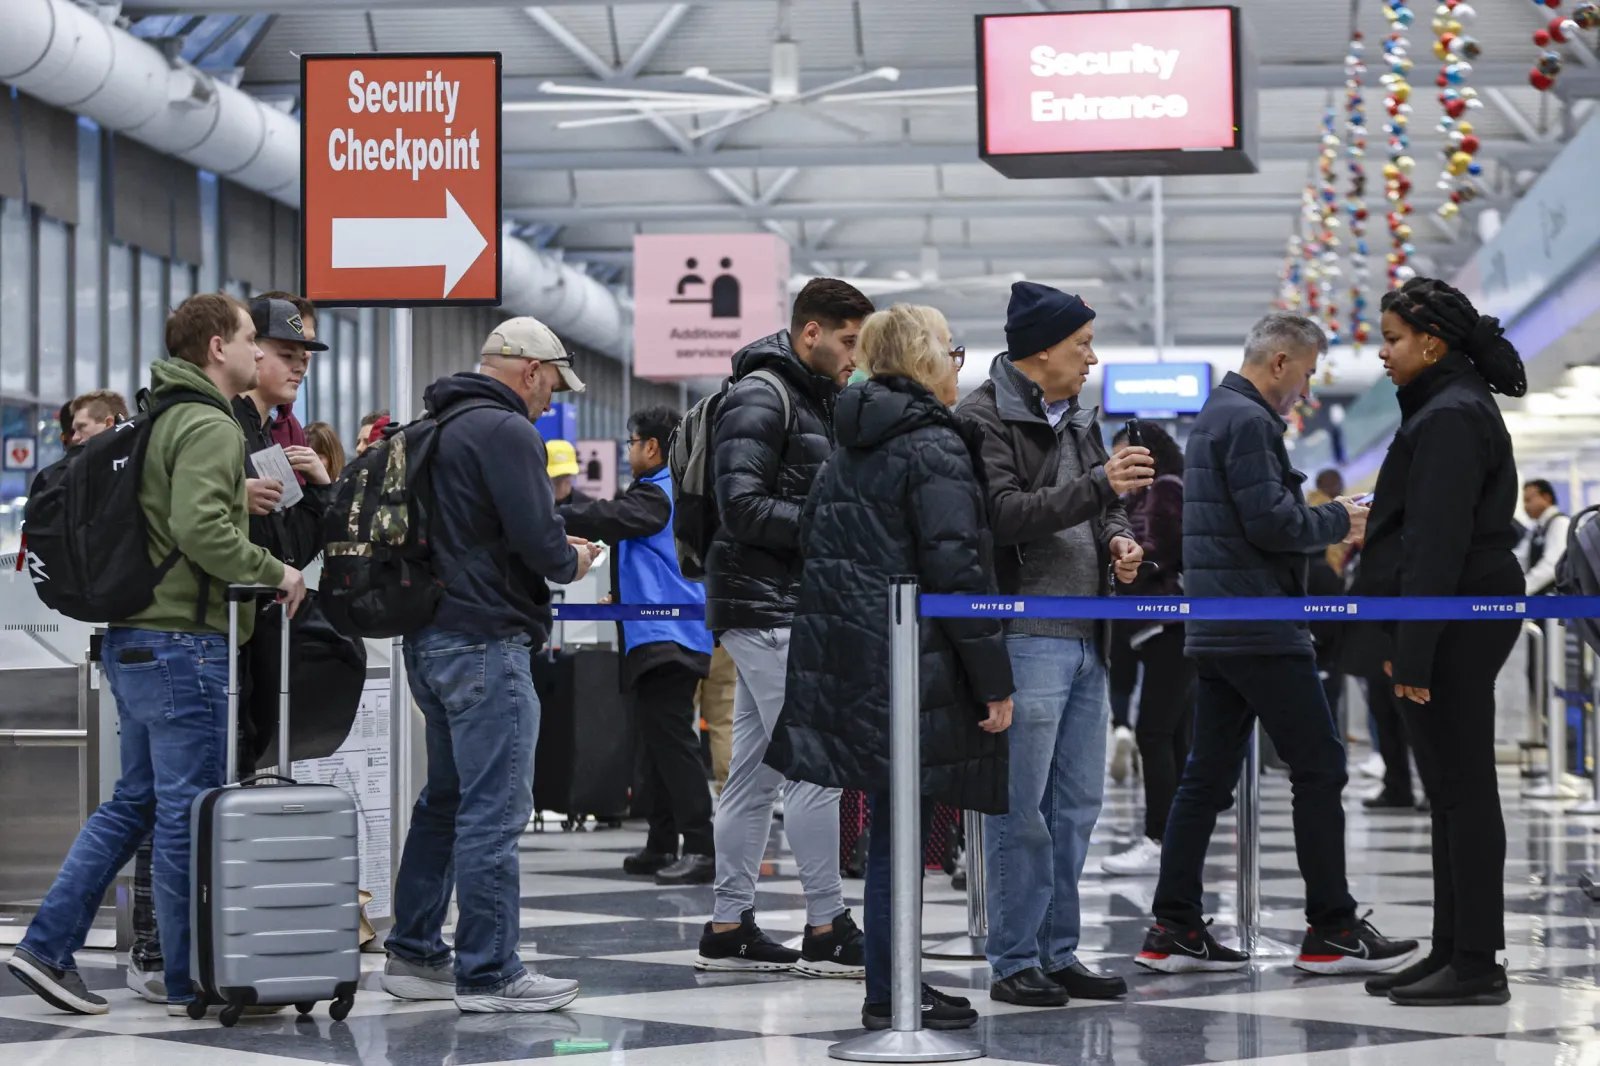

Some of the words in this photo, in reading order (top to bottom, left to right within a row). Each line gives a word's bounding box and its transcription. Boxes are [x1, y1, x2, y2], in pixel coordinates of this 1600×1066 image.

[1030, 43, 1180, 80] Security
[347, 70, 460, 123] Security
[1030, 91, 1188, 122] Entrance
[329, 127, 480, 180] Checkpoint
[670, 327, 741, 339] Additional
[676, 346, 733, 358] services
[971, 602, 1013, 611] UNITED
[1136, 604, 1178, 612] UNITED
[1472, 604, 1514, 612] UNITED
